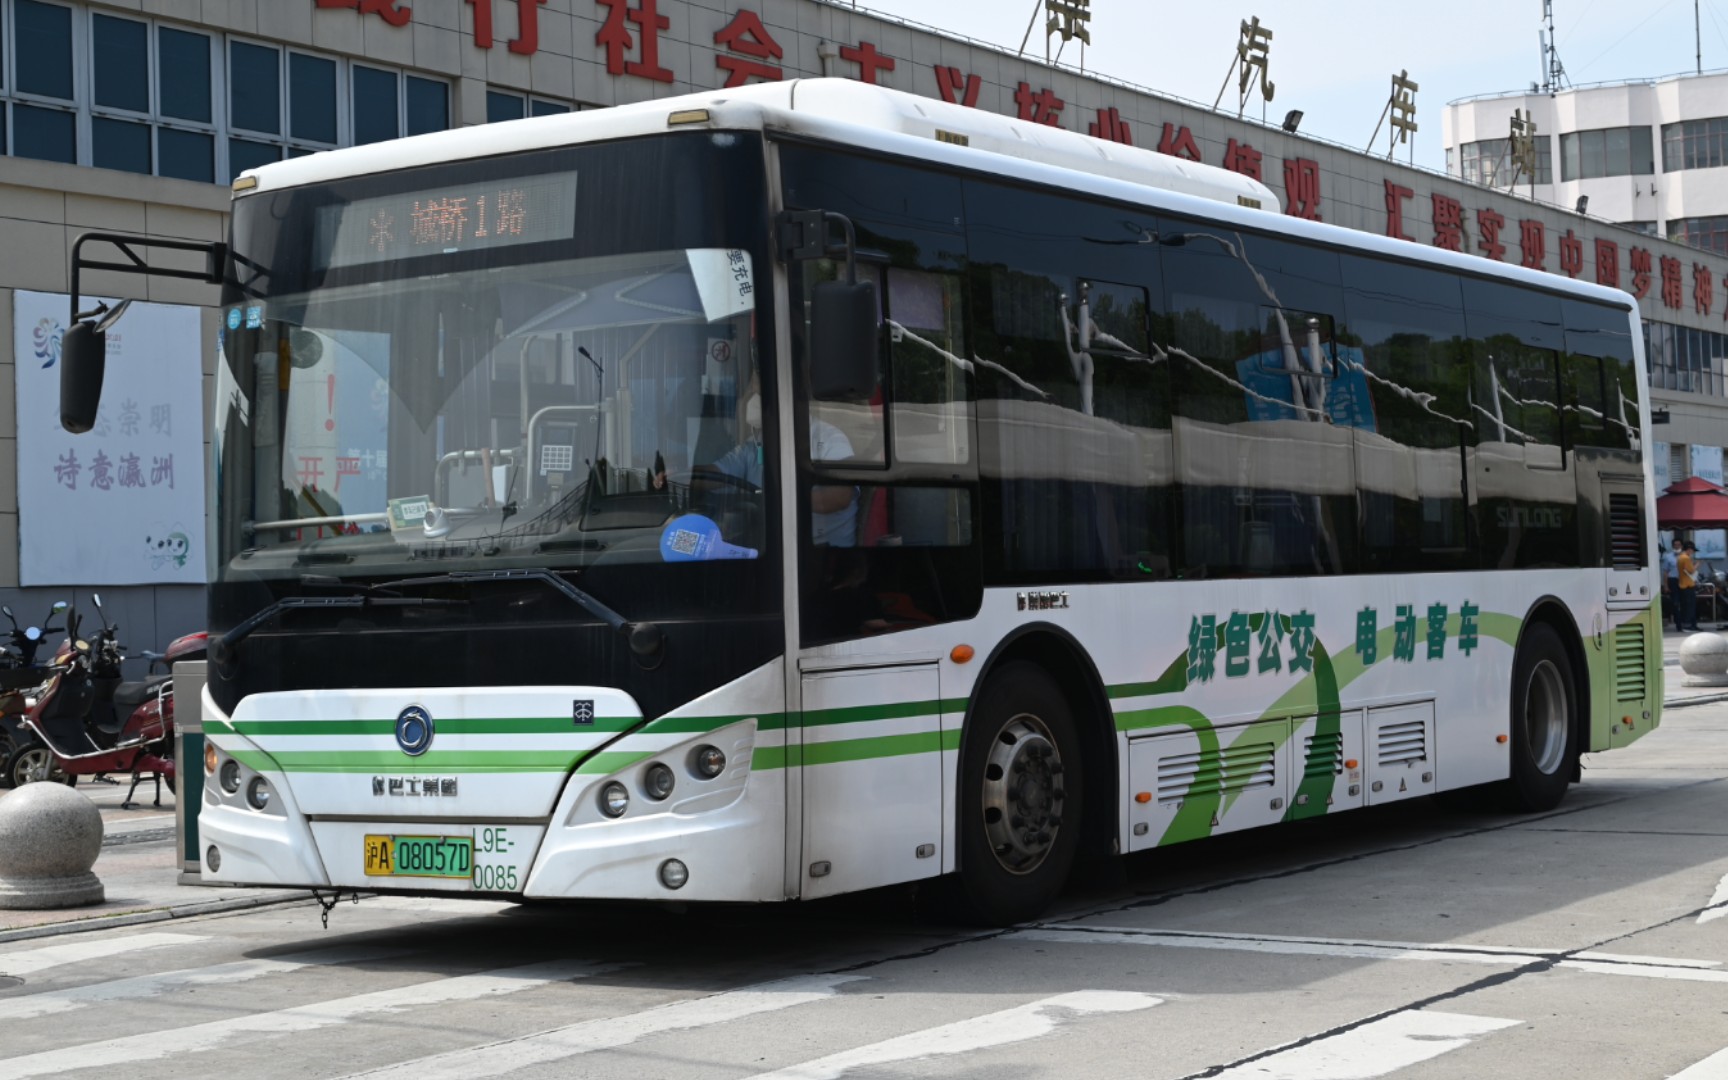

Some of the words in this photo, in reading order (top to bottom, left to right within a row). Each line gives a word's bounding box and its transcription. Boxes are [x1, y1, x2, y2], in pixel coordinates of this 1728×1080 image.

[1384, 178, 1728, 322] 汇聚实现中国梦精神
[53, 398, 173, 437] 崇明
[53, 448, 175, 491] 诗意瀛洲
[1187, 609, 1317, 685] 绿色公交
[1355, 600, 1479, 666] 电动客车
[472, 864, 518, 891] 0085
